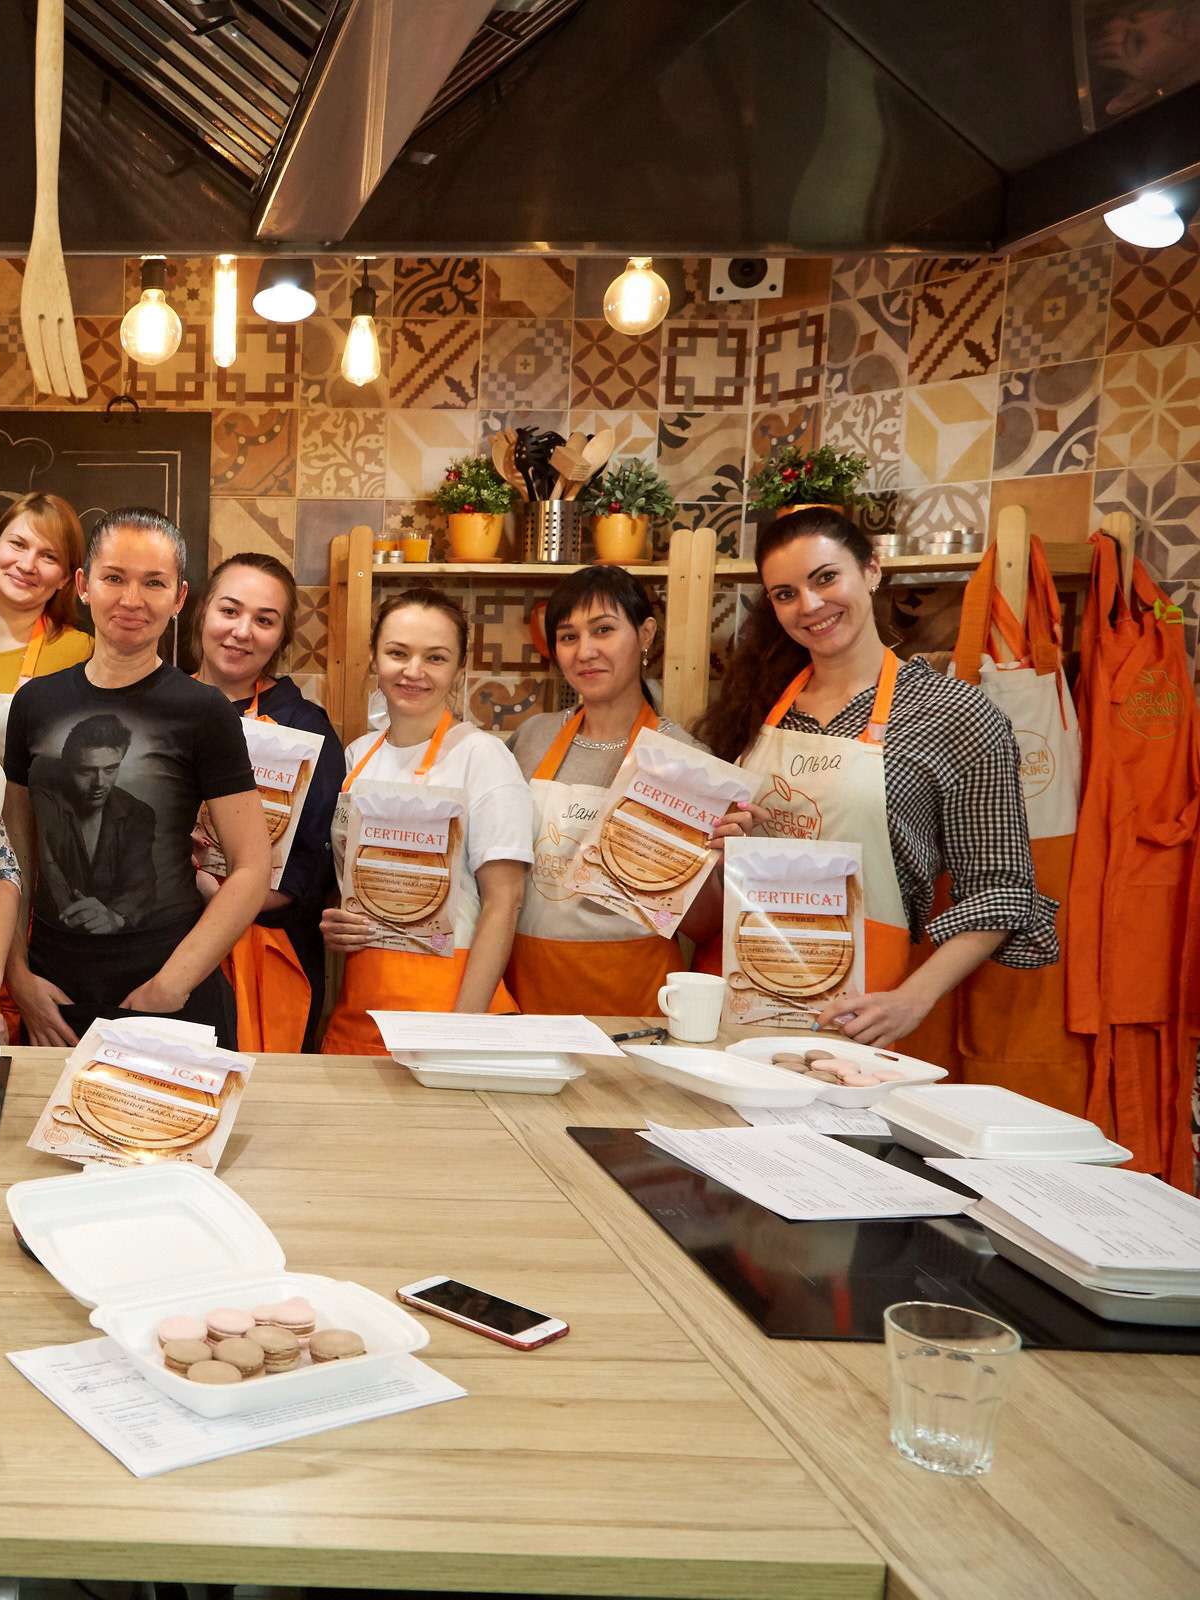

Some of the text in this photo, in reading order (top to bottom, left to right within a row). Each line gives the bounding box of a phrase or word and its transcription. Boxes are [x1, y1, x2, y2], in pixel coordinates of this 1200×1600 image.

[1125, 692, 1178, 706] APELCIN
[1125, 704, 1178, 718] COOKING
[790, 754, 842, 777] Ольга
[633, 780, 720, 826] CERTIFICAT
[765, 808, 818, 830] APELCIN
[364, 827, 446, 846] CERTIFICAT
[766, 820, 813, 840] COOKING
[746, 890, 843, 907] CERTIFICAT
[125, 1072, 178, 1092] участника
